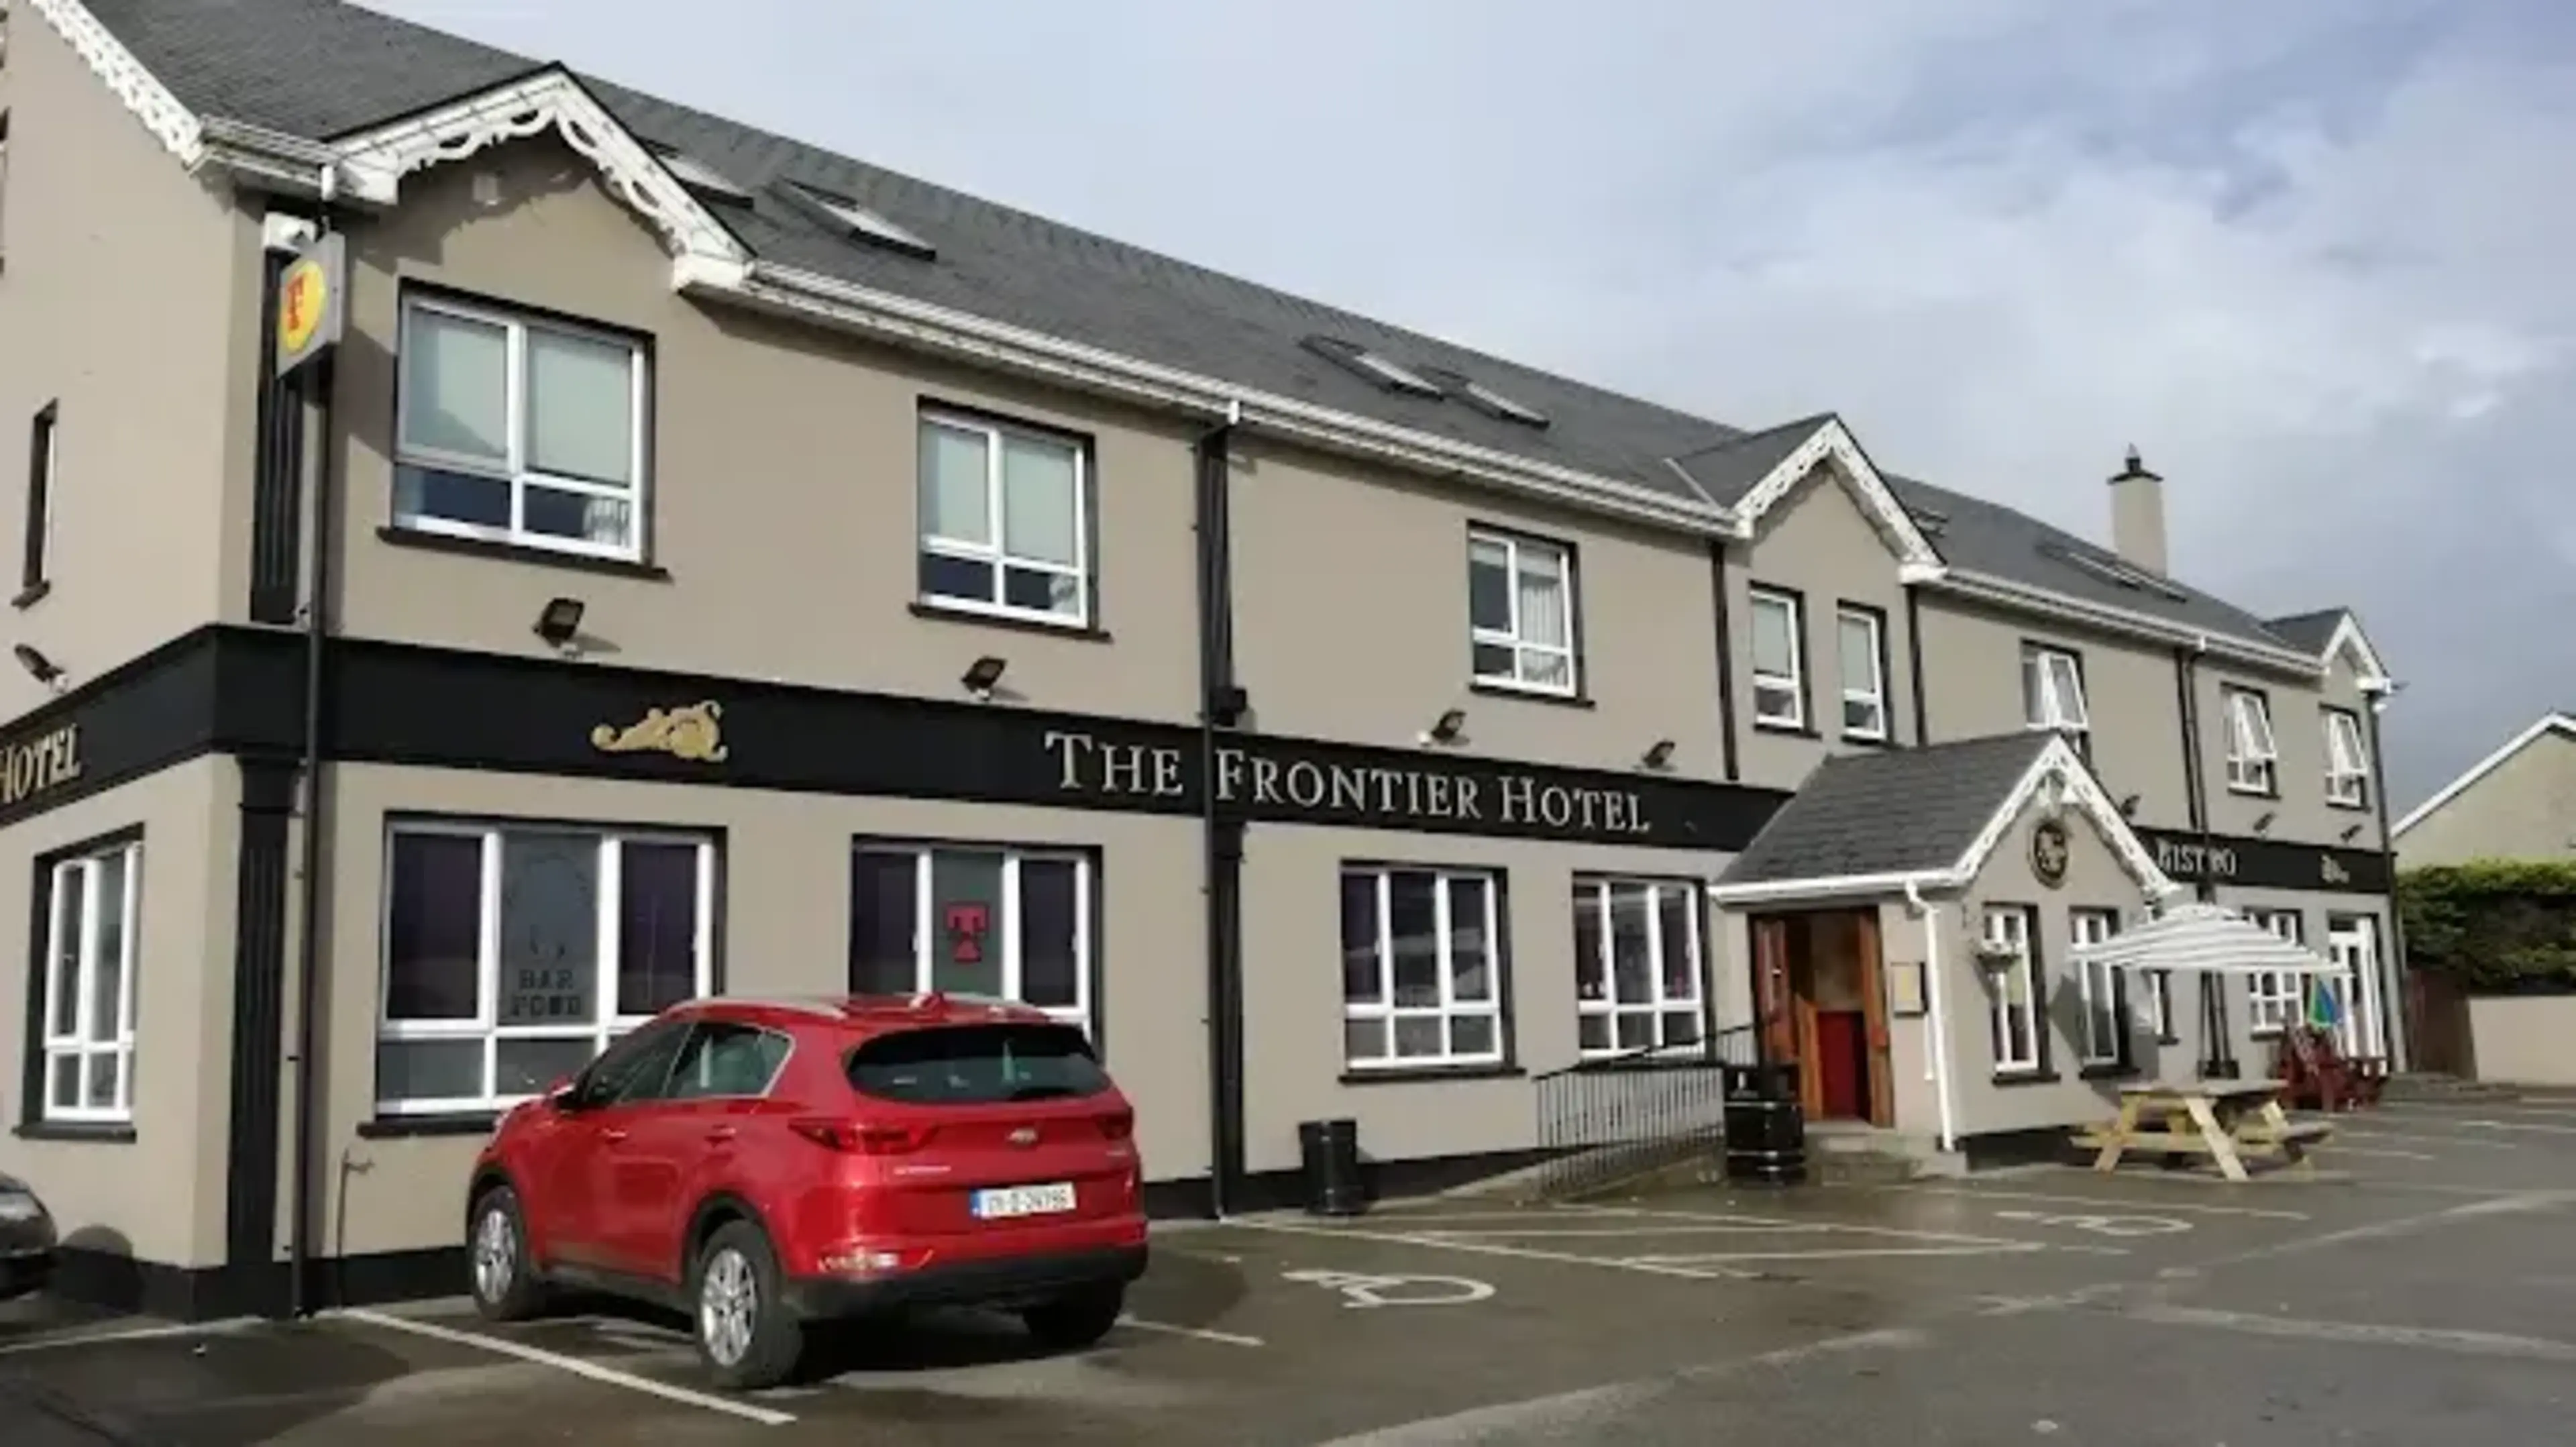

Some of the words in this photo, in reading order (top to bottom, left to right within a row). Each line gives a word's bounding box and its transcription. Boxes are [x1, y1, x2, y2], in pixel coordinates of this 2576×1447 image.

[1044, 730, 1183, 796] THE
[1215, 748, 1483, 819] FRONTIER
[1497, 776, 1652, 835] HOTEL
[2155, 837, 2237, 876] BISTRO
[519, 969, 574, 990] BAR
[511, 994, 582, 1016] FOOD
